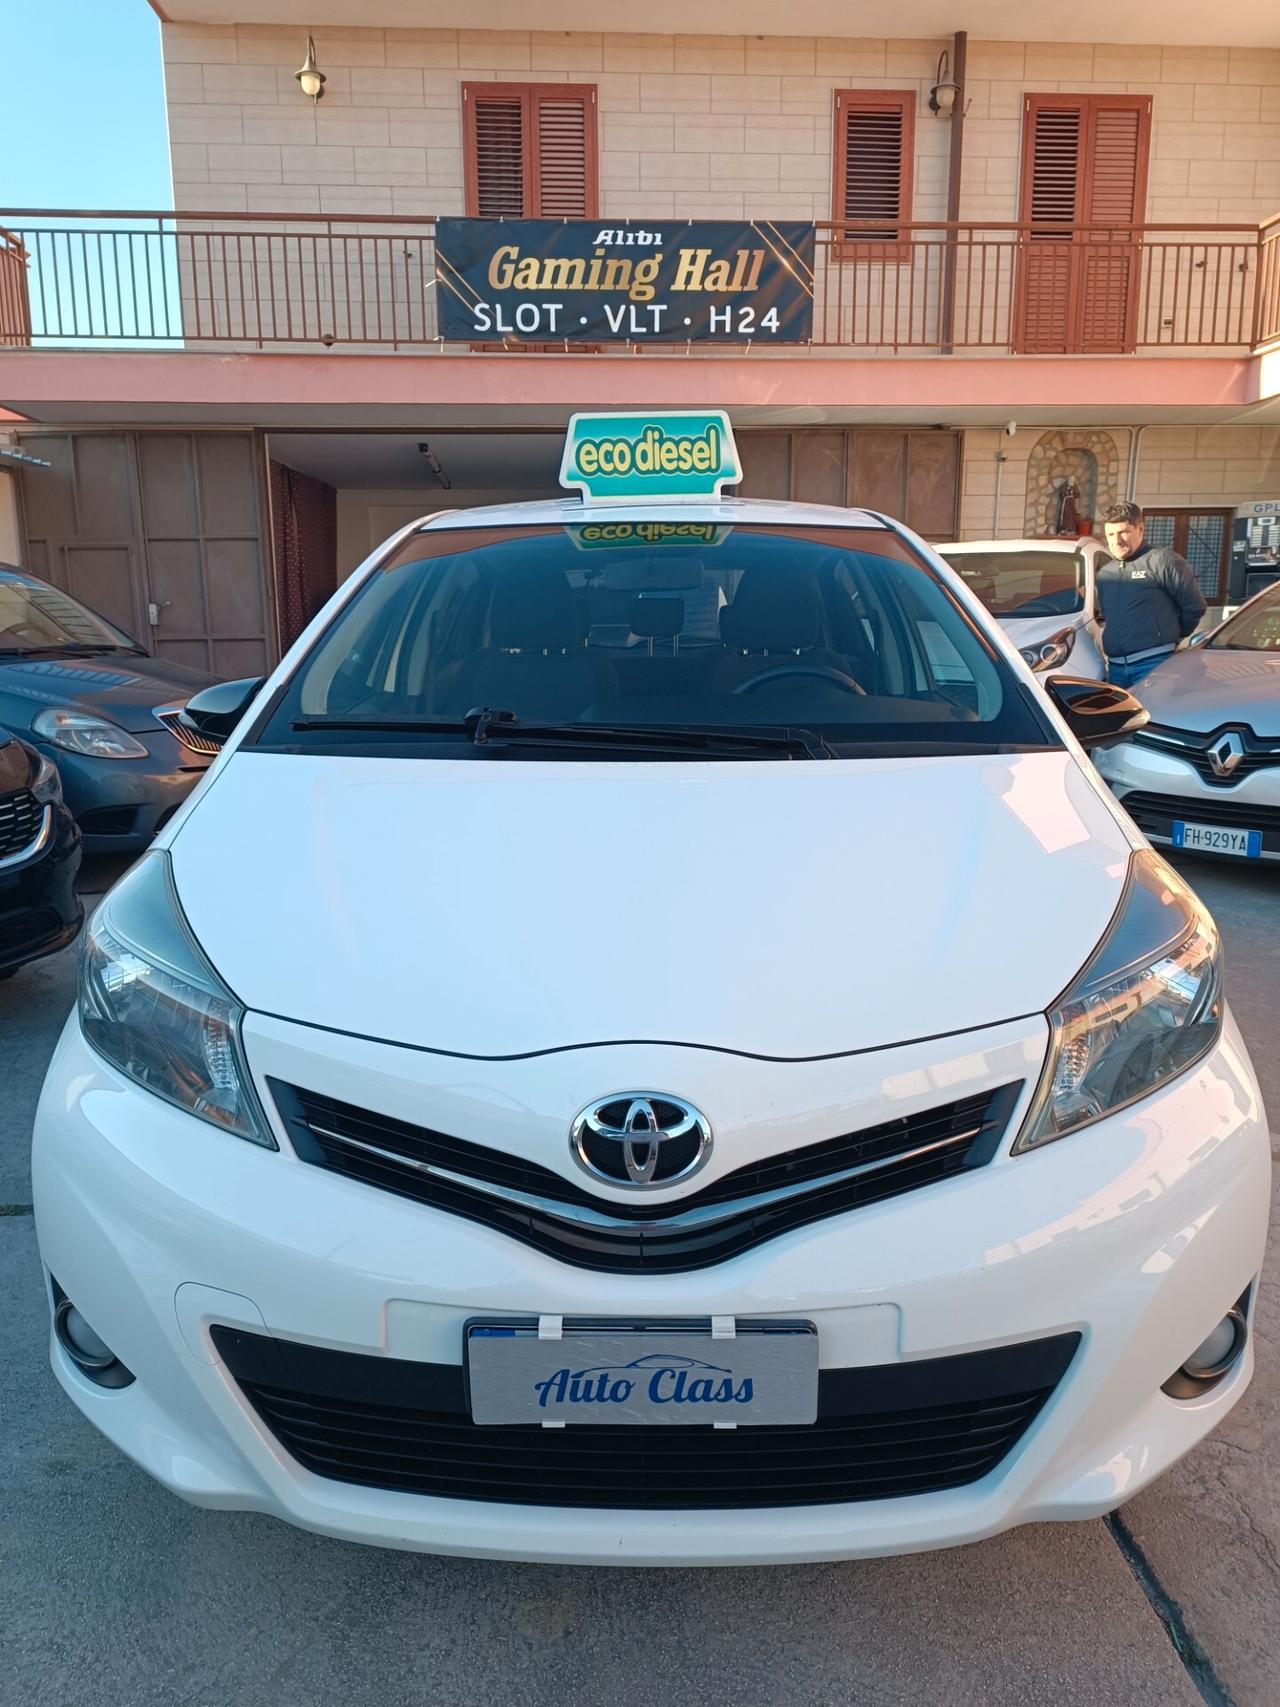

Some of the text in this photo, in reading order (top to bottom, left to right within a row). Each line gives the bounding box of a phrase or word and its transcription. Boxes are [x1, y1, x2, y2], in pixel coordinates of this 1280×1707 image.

[592, 229, 663, 246] Alibi
[488, 245, 765, 301] Gaming Hall
[473, 303, 781, 334] SLOT VLT H24
[534, 1368, 755, 1408] Auto Class
